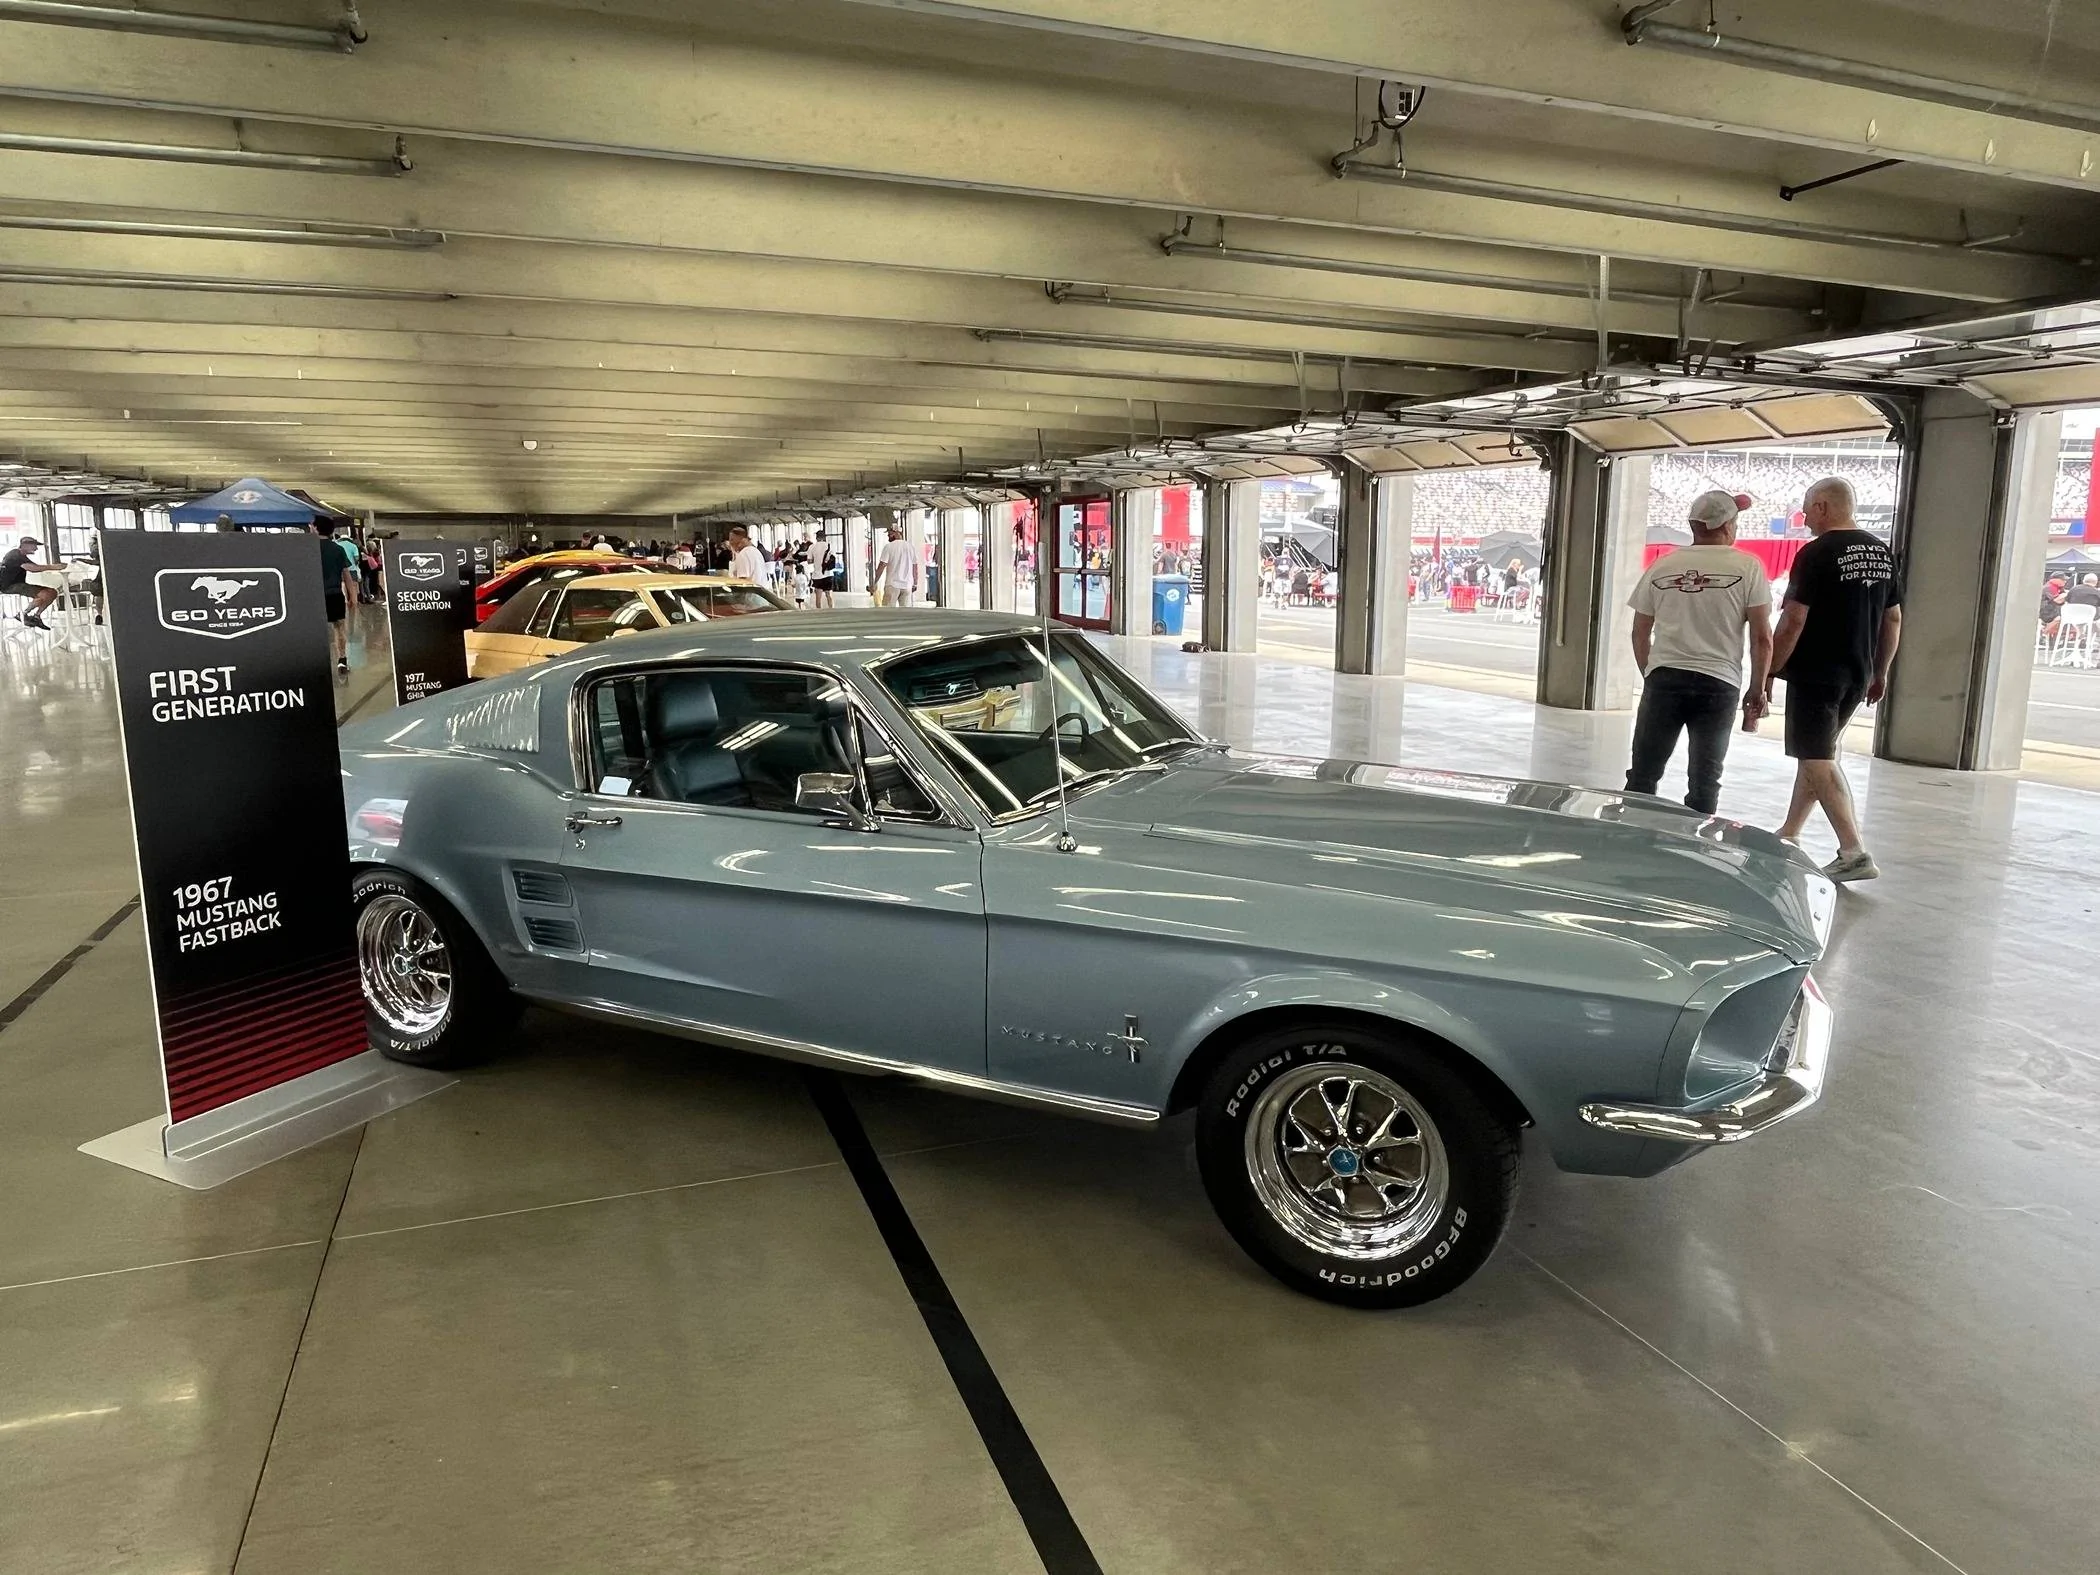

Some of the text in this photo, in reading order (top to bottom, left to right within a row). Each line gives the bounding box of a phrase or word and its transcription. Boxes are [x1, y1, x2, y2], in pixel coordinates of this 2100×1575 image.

[1840, 571, 1859, 581] FOR
[1861, 570, 1867, 578] A
[396, 590, 441, 602] SECOND
[397, 601, 452, 611] GENERATION
[171, 606, 276, 622] 60 YEARS
[149, 666, 237, 698] FIRST
[405, 672, 425, 683] 1977
[406, 680, 442, 691] MUSTANG
[152, 687, 305, 723] GENERATION
[406, 691, 425, 700] GHIA
[173, 875, 233, 909] 1967
[177, 891, 278, 931] MUSTANG
[179, 911, 282, 953] FASTBACK
[1001, 1024, 1113, 1056] MUSTANG
[1226, 1043, 1347, 1117] Radial T/A
[1318, 1206, 1468, 1289] BFGoodrich
